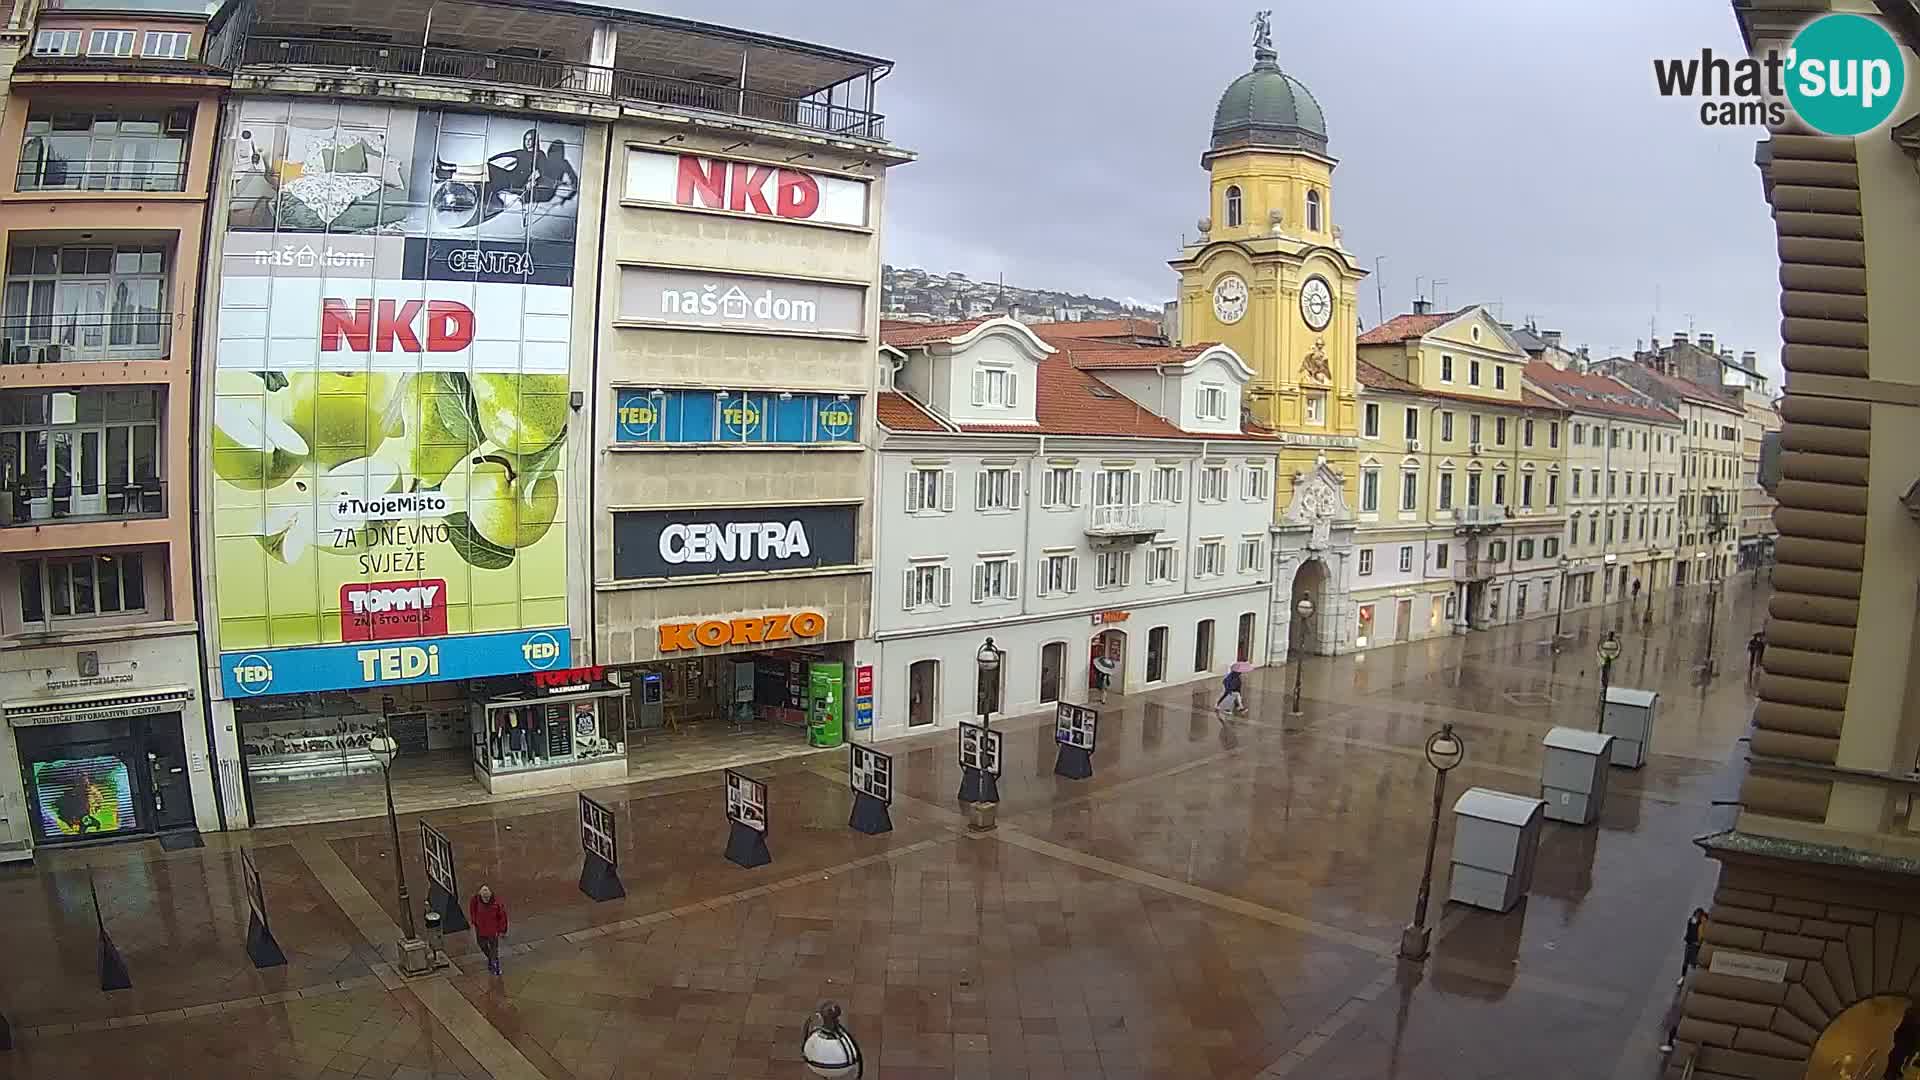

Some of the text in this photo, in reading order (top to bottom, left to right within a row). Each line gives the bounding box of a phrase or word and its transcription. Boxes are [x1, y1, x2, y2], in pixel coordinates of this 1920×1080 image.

[675, 154, 820, 219] NKD
[255, 245, 367, 268] naš dom
[447, 248, 535, 276] CENTRA
[660, 283, 816, 322] naš dom
[320, 297, 476, 353] NKD
[619, 407, 657, 425] TEDi
[723, 408, 760, 425] TEDi
[819, 410, 853, 426] TEDi
[338, 496, 446, 516] #TvojeMisto
[333, 523, 450, 548] ZA DNEVNO
[658, 519, 810, 564] CENTRA
[359, 547, 426, 575] SVJEŽE
[348, 585, 440, 614] TOMMY
[379, 613, 401, 625] ŠTO
[658, 612, 825, 653] KORZO
[357, 643, 439, 683] TEDi
[521, 641, 560, 661] TEDi
[233, 664, 273, 685] TEDi
[132, 704, 162, 716] CENTAR
